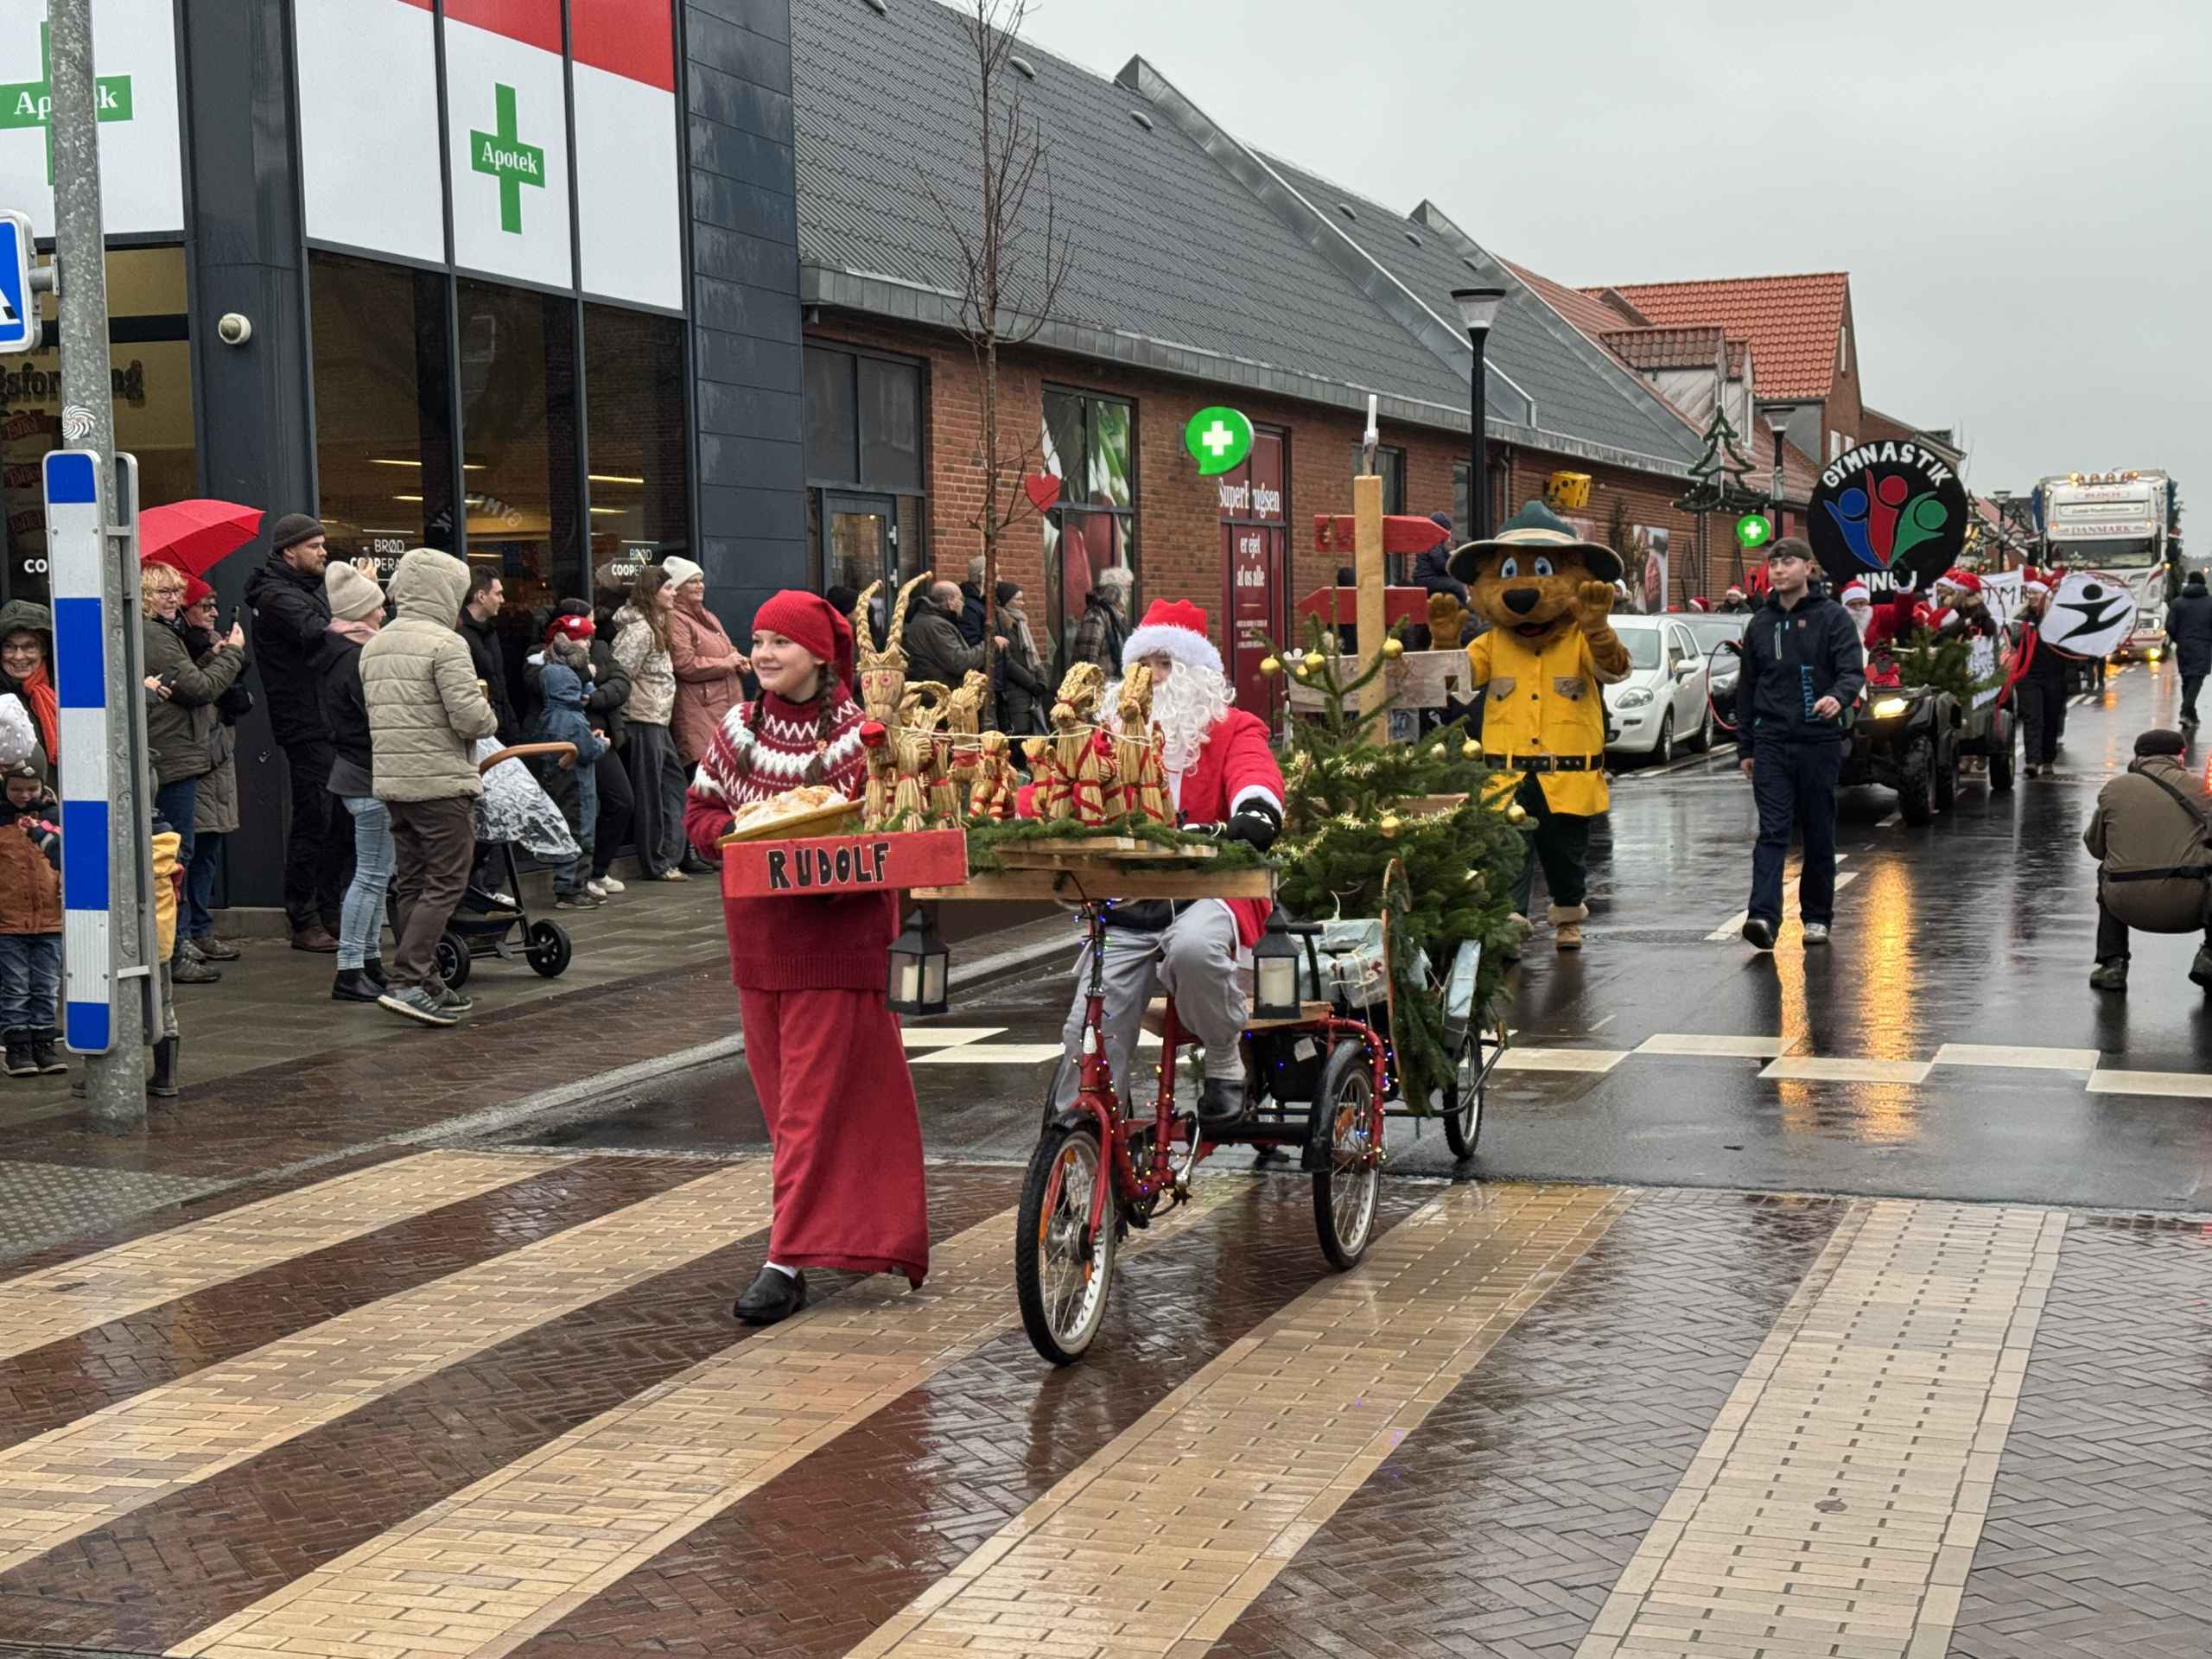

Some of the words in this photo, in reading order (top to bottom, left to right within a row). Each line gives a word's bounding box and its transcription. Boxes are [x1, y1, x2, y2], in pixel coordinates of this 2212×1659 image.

[14, 85, 118, 120] Apk
[482, 141, 538, 175] Apotek
[1822, 442, 1953, 488] GYMNASTIK
[374, 538, 405, 554] BRØD
[2072, 524, 2131, 535] DANMARK
[766, 842, 889, 889] RUDOLF
